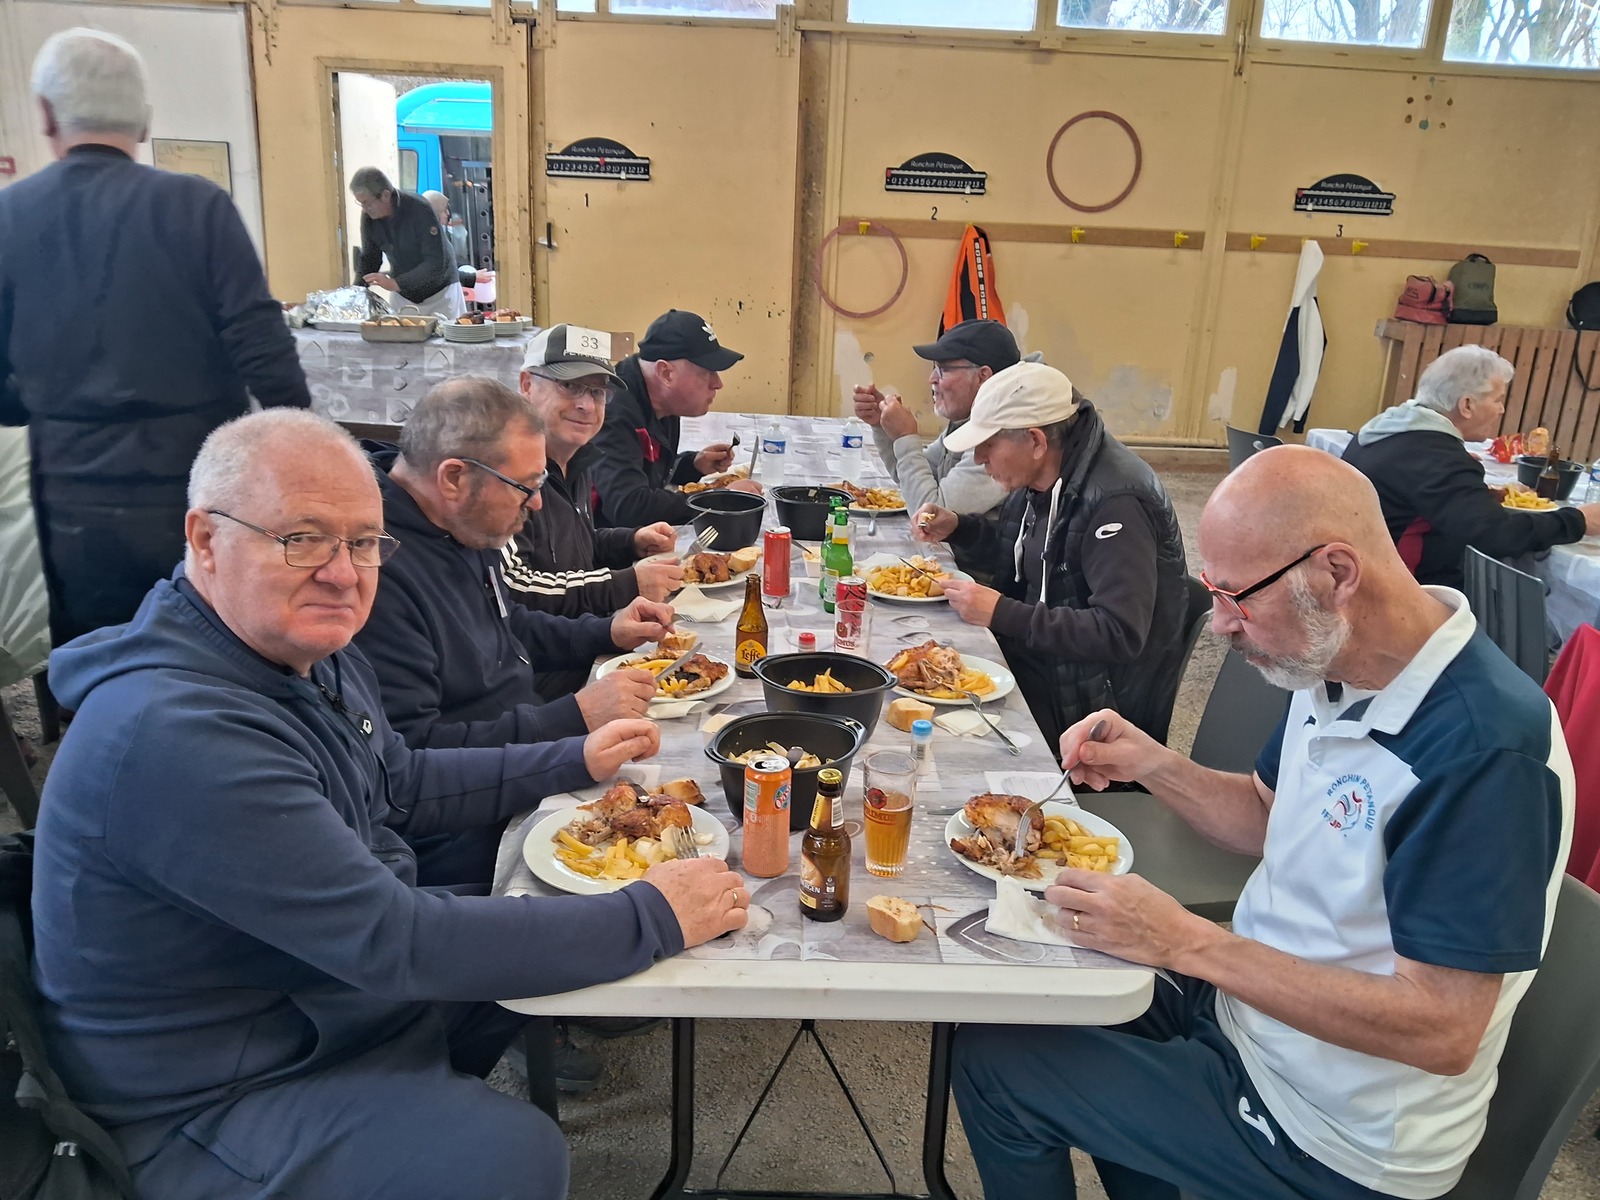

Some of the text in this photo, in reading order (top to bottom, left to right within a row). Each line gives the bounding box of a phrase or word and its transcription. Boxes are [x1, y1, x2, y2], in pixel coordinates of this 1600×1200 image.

[585, 192, 589, 208] 1
[931, 206, 938, 220] 2
[1336, 224, 1343, 238] 3
[580, 336, 599, 350] 33
[742, 648, 760, 662] Leffe
[1327, 774, 1376, 832] RONCHIN PETANQUE
